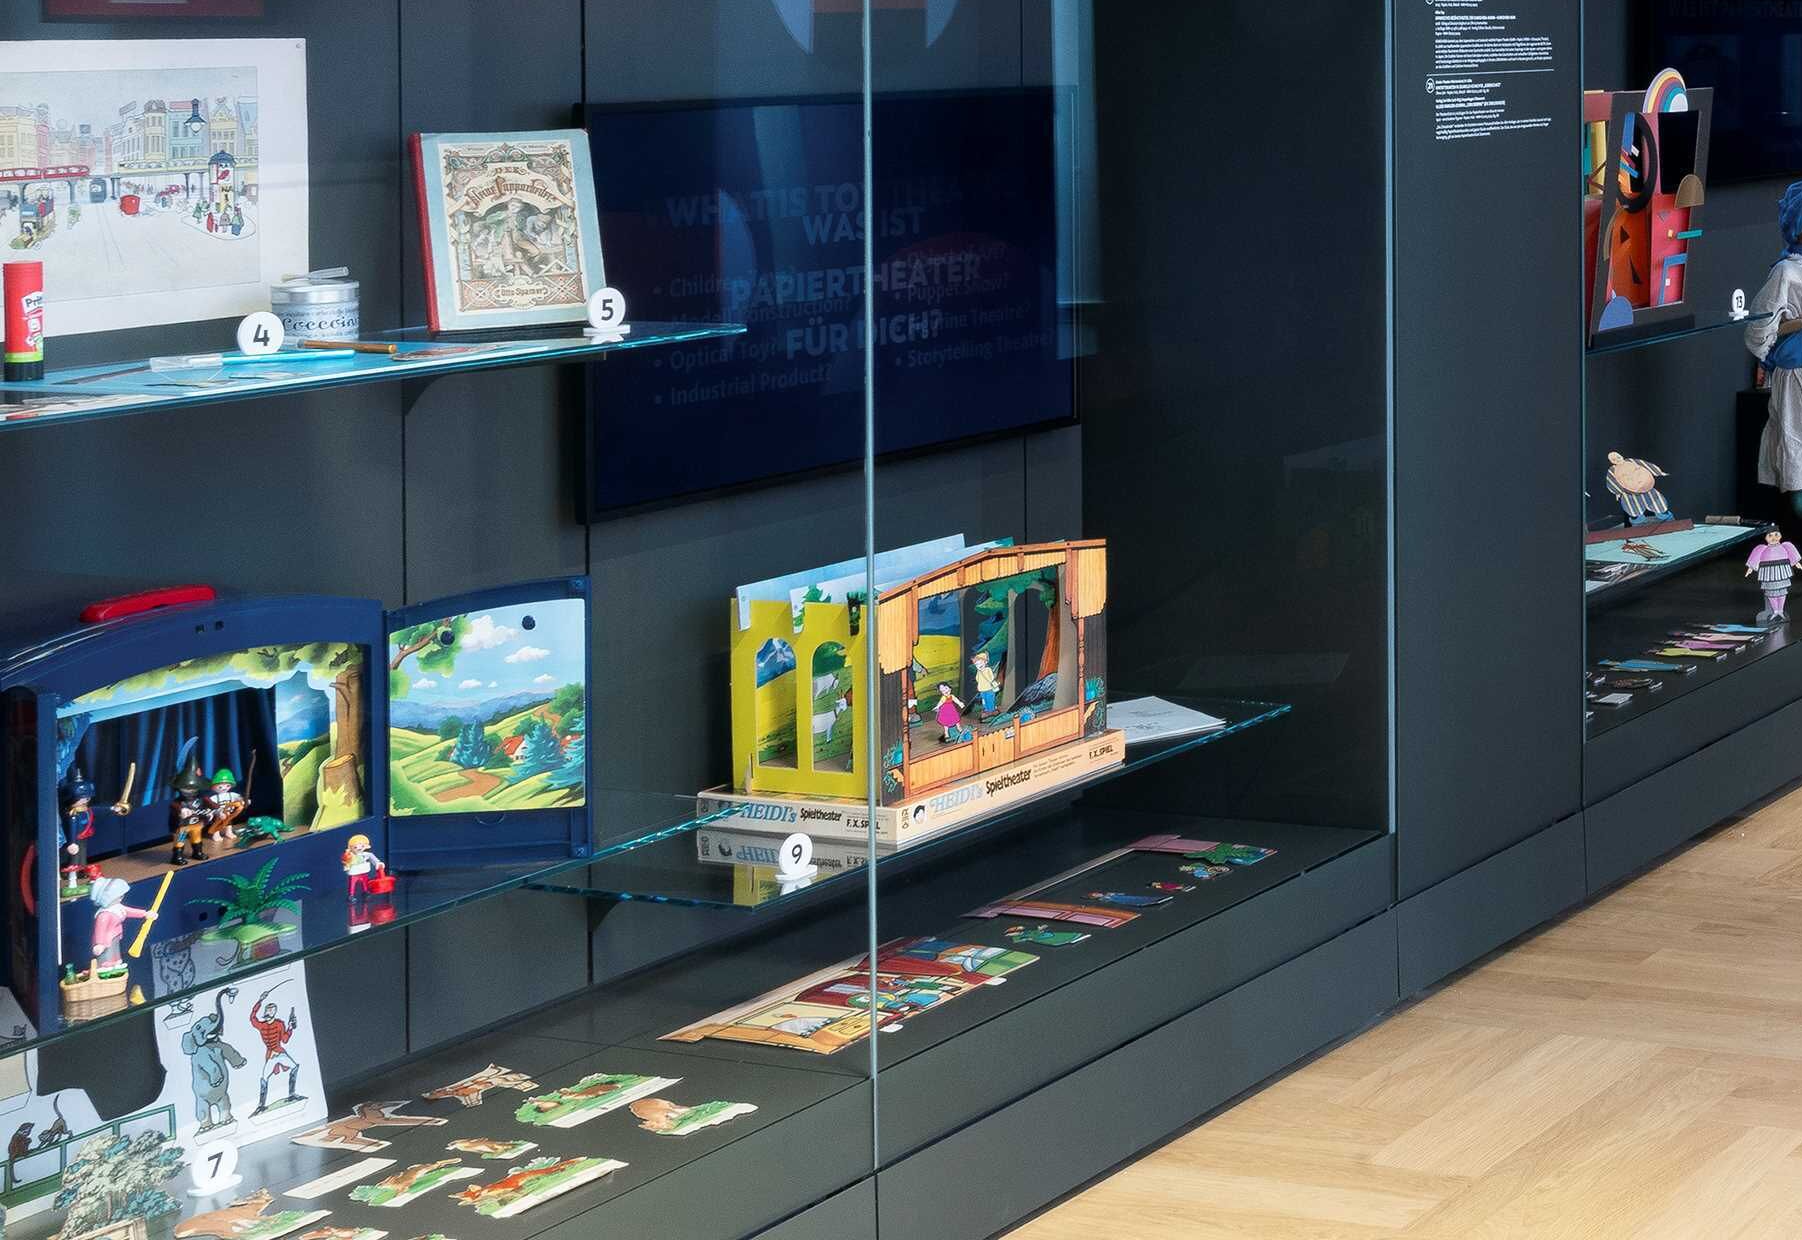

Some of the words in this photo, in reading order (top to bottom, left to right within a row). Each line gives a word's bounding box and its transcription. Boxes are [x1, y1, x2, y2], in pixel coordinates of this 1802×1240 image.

[601, 299, 614, 321] 5
[253, 323, 270, 347] 4
[786, 317, 849, 361] FÜR
[986, 768, 1033, 798] Spieltheater
[800, 807, 843, 823] Spieltheater
[791, 844, 803, 865] 9
[208, 1151, 225, 1177] 7
